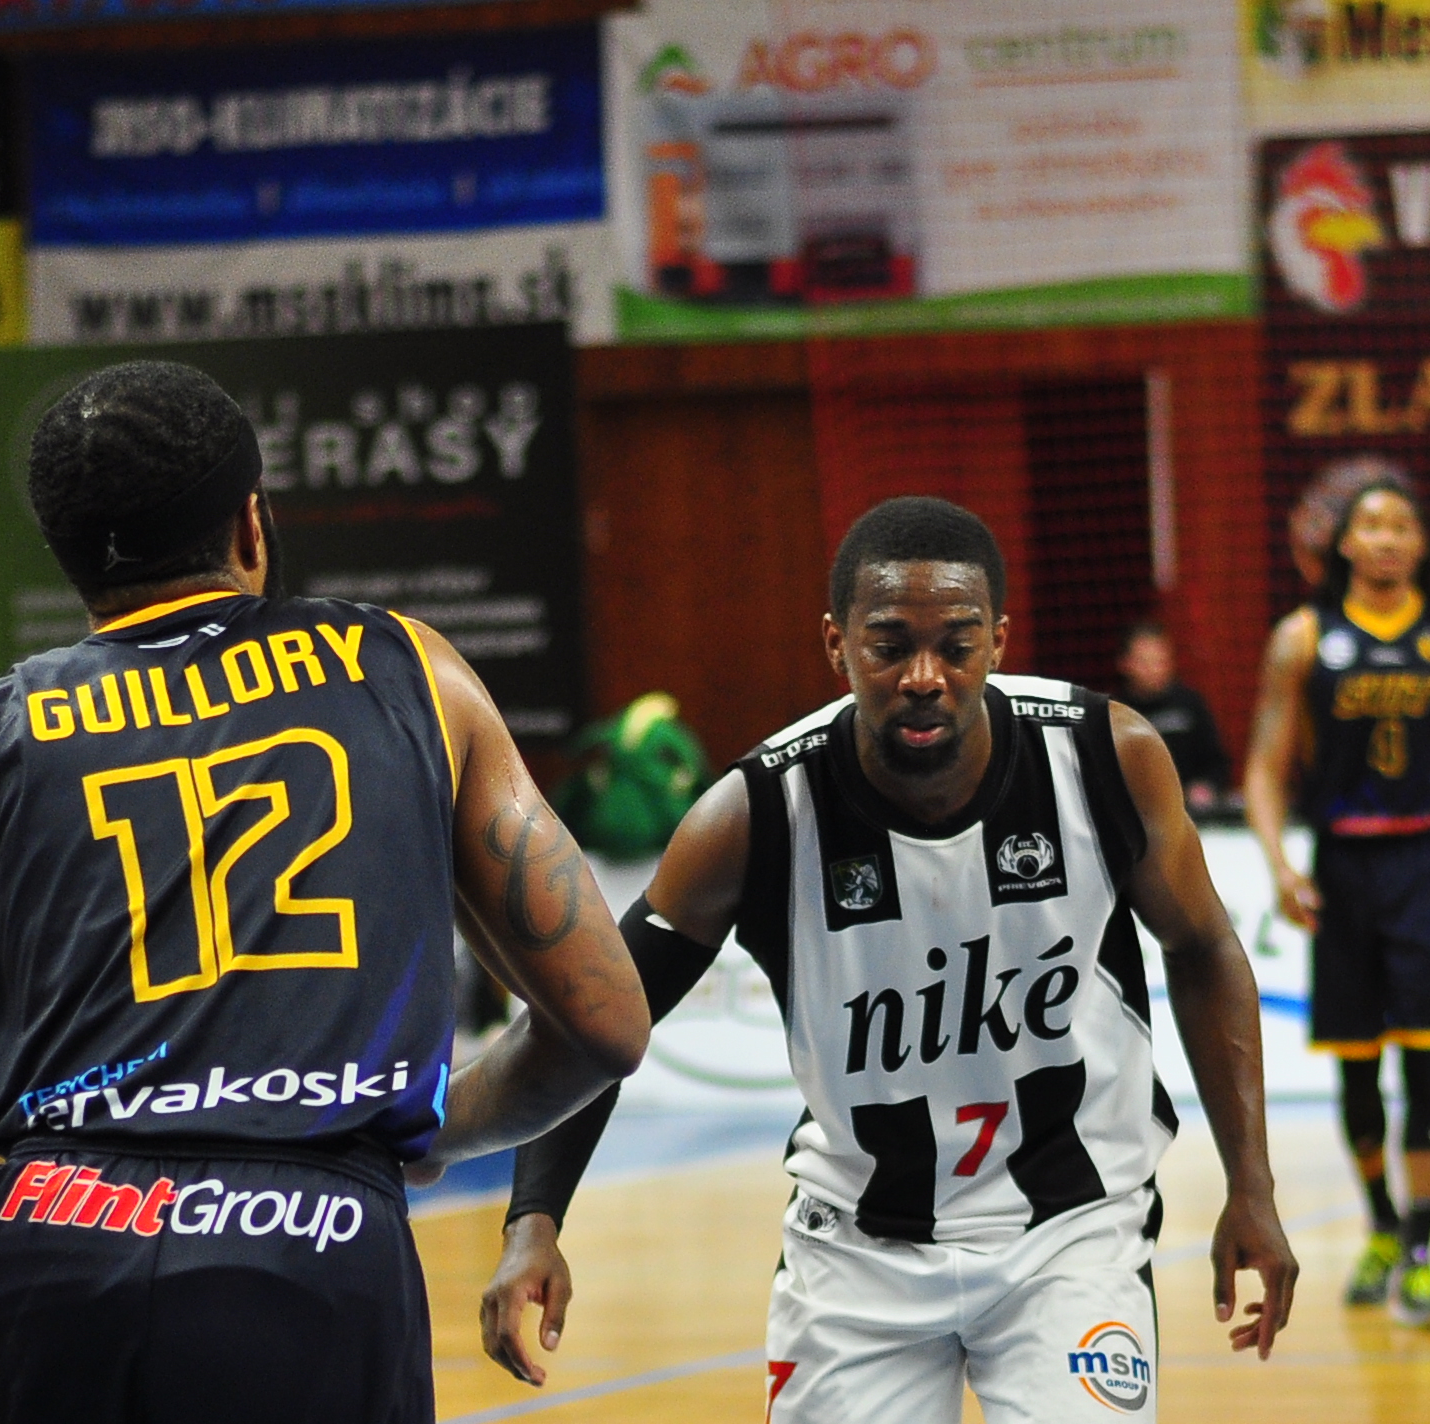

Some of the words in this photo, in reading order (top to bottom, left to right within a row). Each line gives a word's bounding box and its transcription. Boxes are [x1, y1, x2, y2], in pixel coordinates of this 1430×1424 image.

[734, 27, 937, 93] AGRO
[27, 624, 364, 743] GUILLORY
[1010, 697, 1086, 721] brose
[761, 731, 829, 769] brose
[82, 727, 359, 1003] 12
[843, 934, 1079, 1075] niké
[952, 1101, 1009, 1177] 7
[1066, 1351, 1151, 1385] msm
